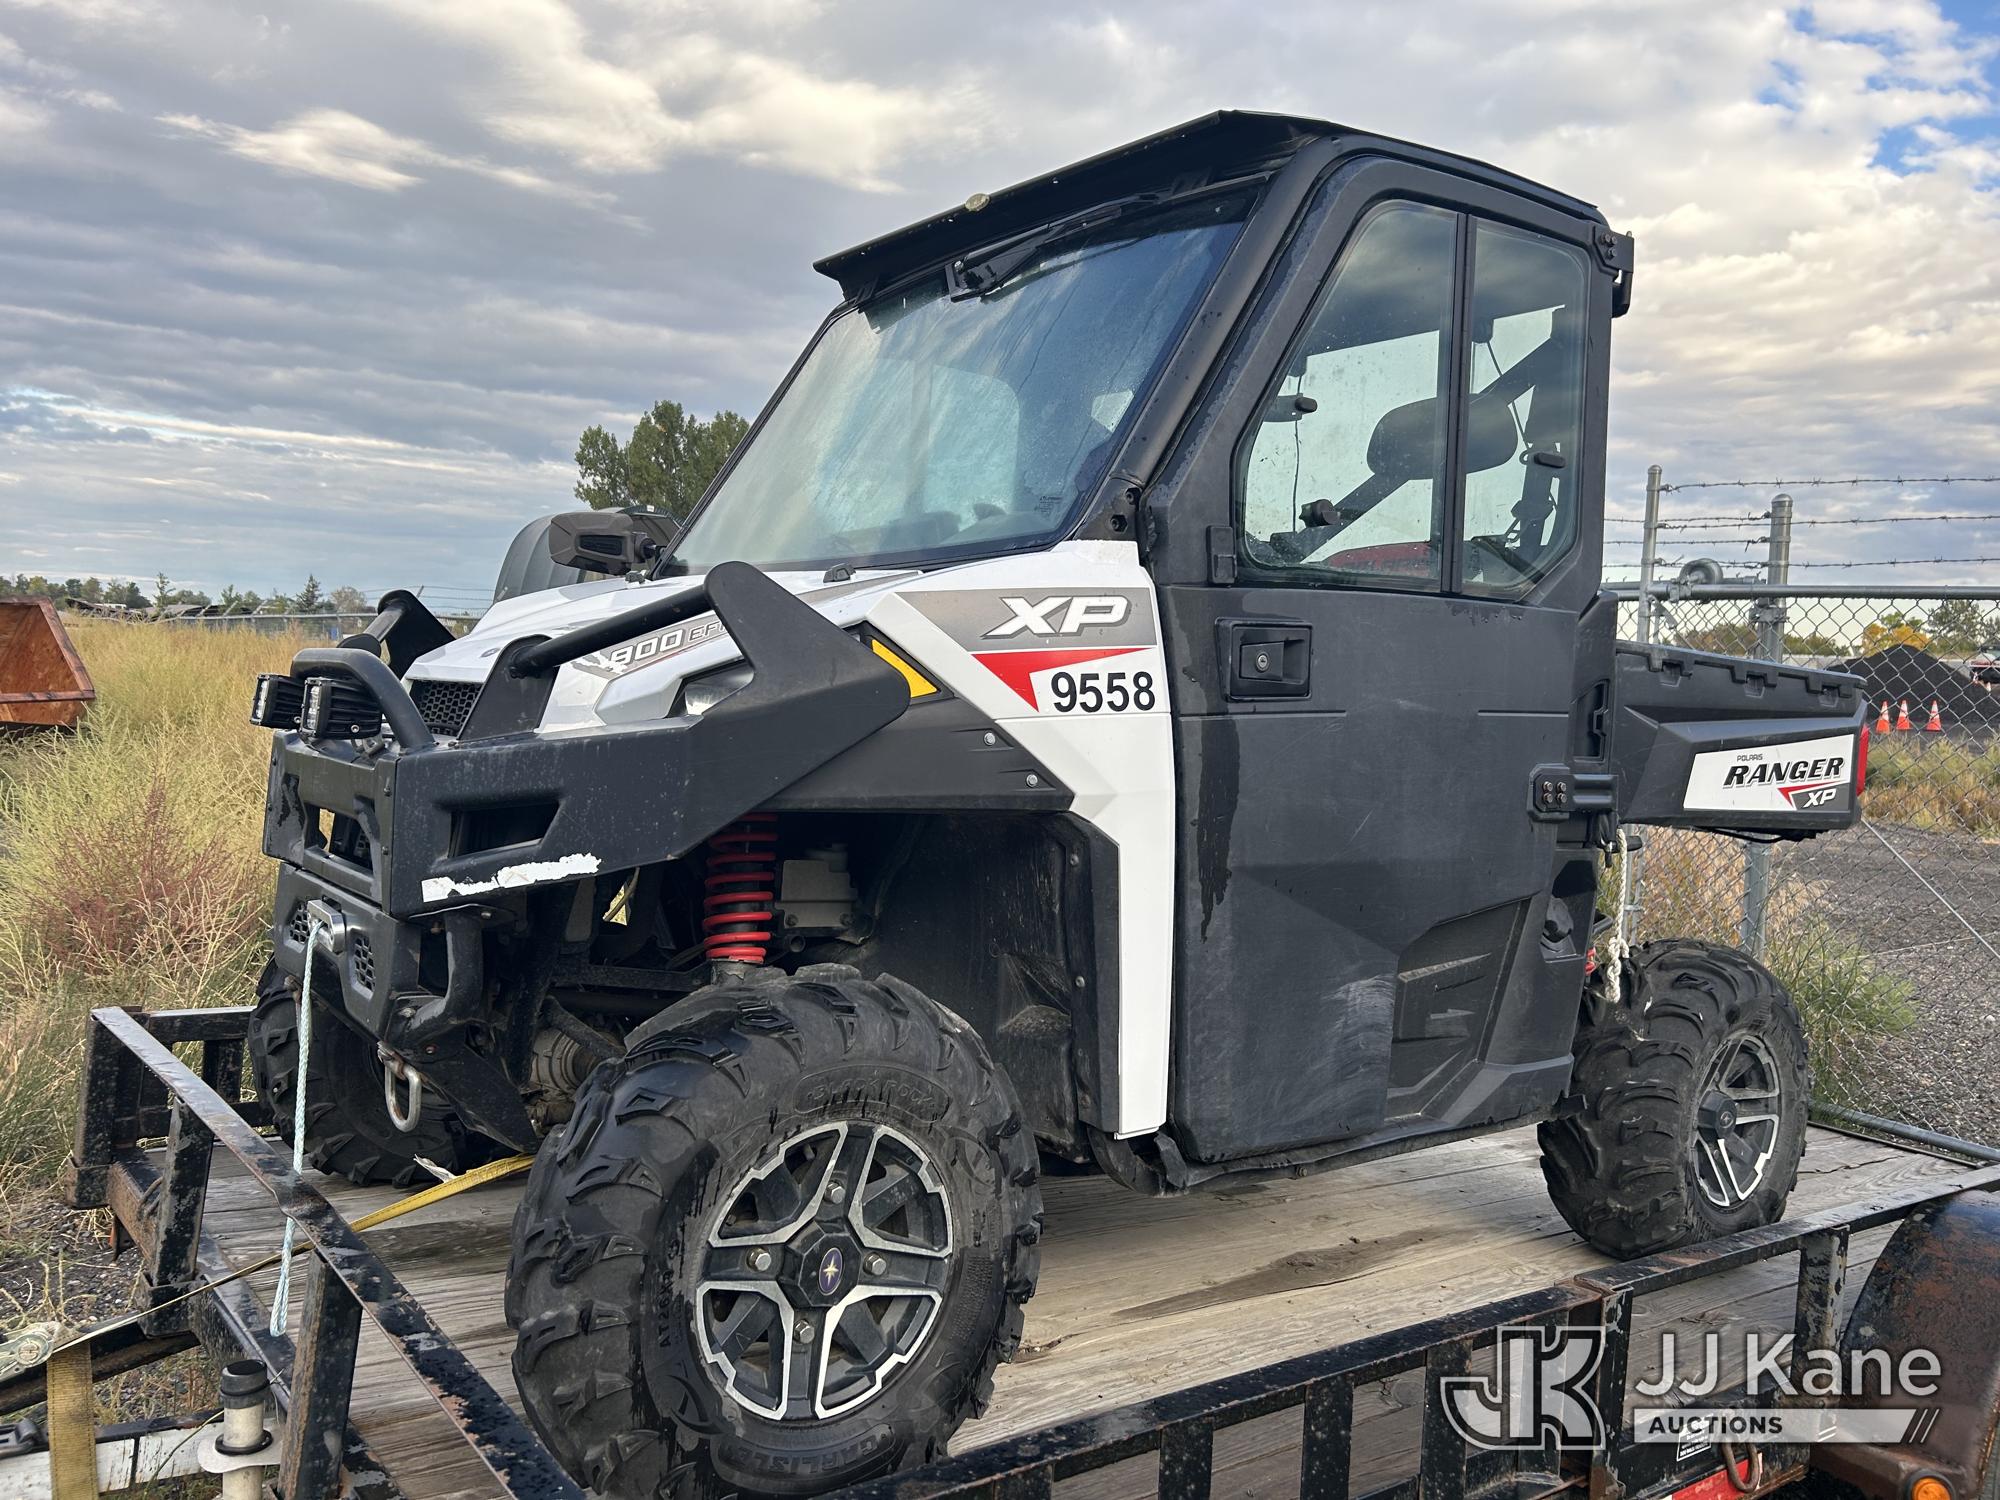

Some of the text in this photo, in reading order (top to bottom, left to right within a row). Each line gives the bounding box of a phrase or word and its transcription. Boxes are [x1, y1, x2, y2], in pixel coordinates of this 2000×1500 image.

[981, 596, 1129, 639] XP
[610, 629, 685, 666] 900
[1050, 671, 1155, 713] 9558
[1722, 757, 1844, 788] RANGER
[1736, 753, 1763, 762] POLARIS
[1803, 788, 1837, 808] XP
